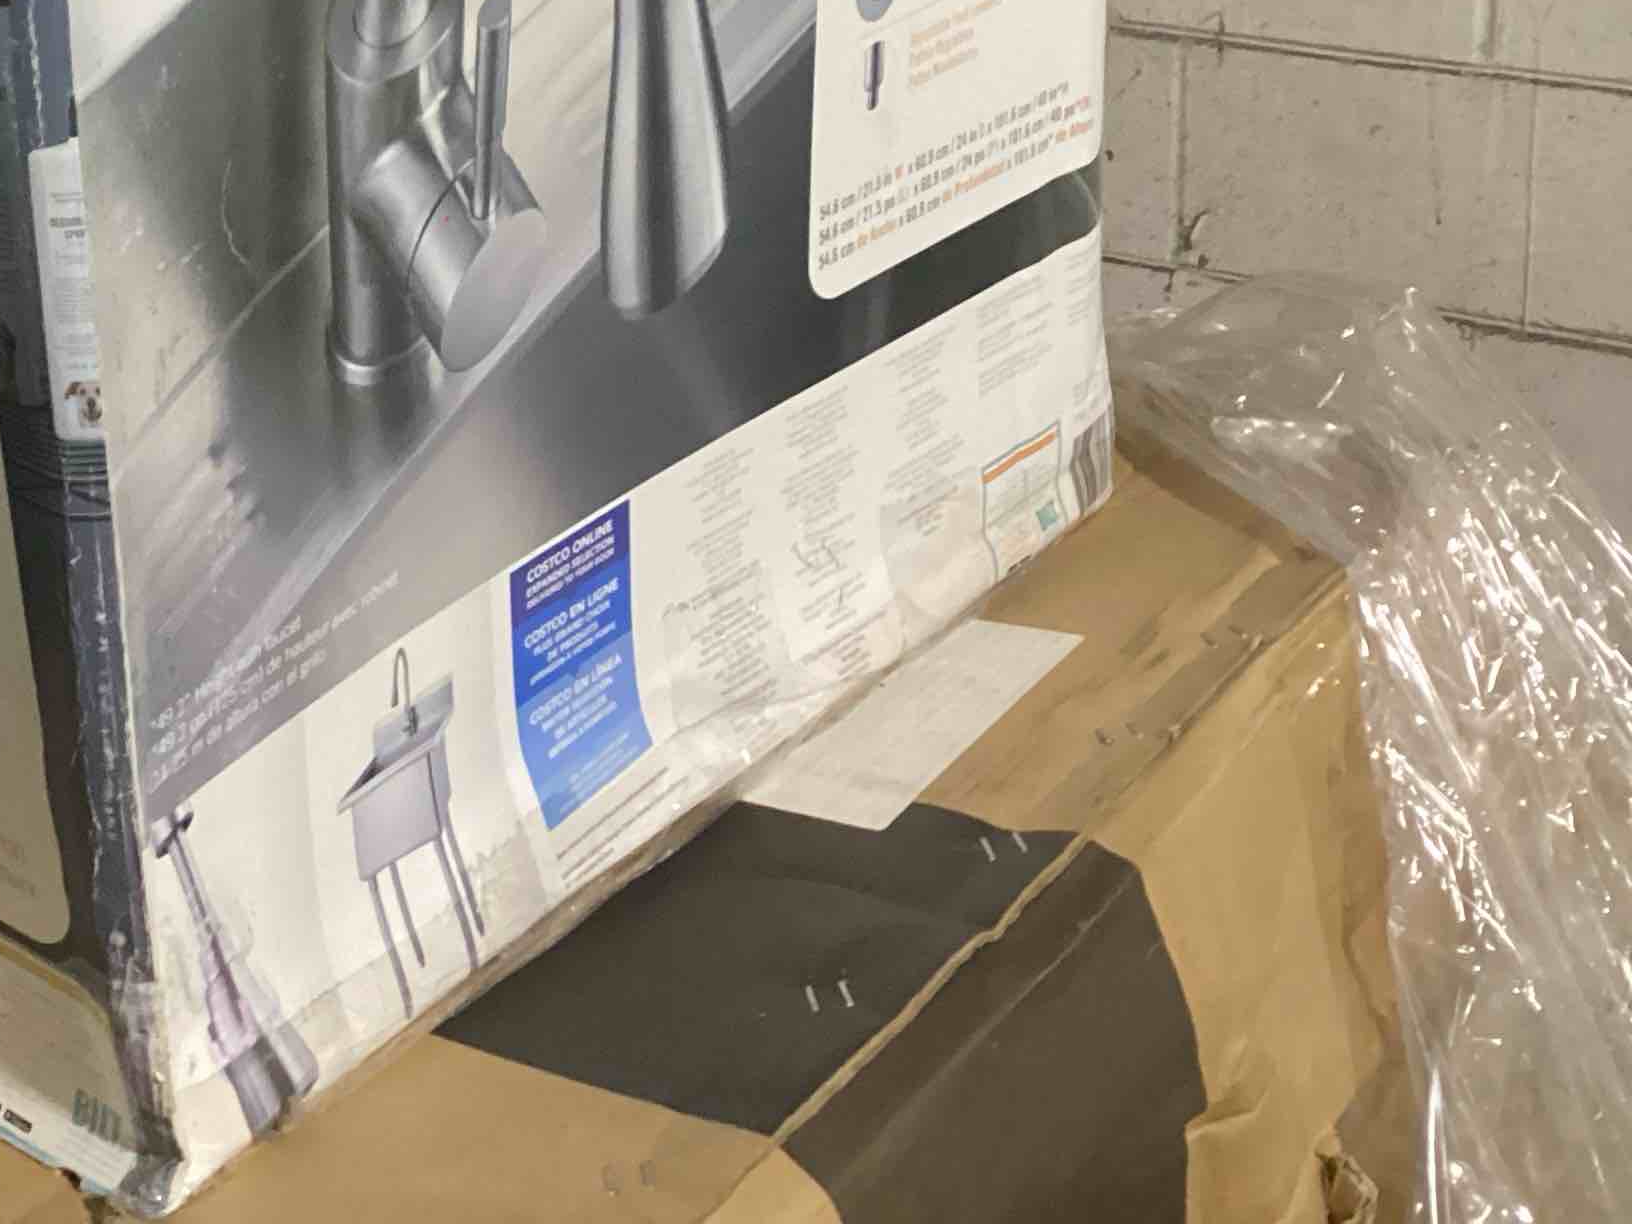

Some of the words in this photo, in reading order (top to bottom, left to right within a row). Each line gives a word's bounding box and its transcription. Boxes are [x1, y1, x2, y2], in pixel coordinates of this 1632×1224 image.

[527, 546, 570, 583] COSTCO
[571, 518, 614, 554] ONLINE
[524, 611, 568, 648] COSTCO
